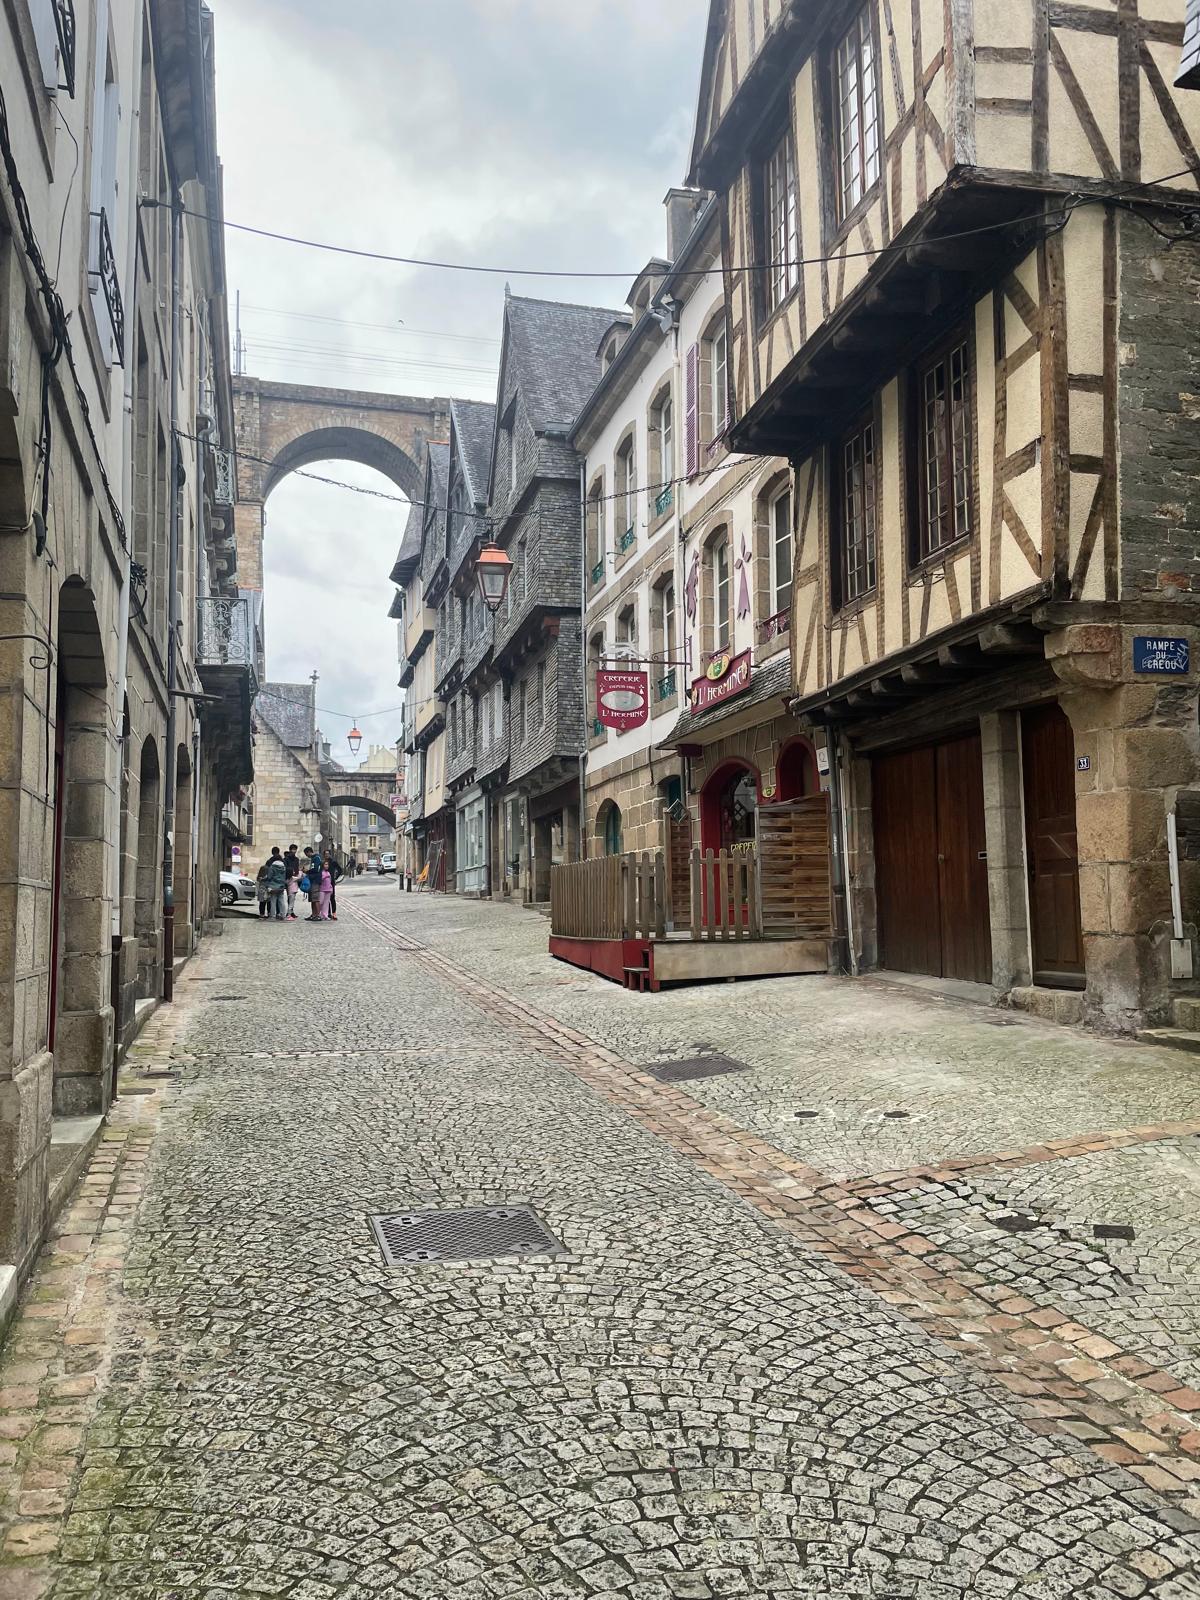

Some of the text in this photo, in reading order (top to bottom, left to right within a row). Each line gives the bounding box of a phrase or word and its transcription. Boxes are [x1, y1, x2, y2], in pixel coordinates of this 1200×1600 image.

[1146, 641, 1175, 650] RAMPE
[1155, 651, 1166, 660] DU
[603, 675, 641, 683] CREPERIE
